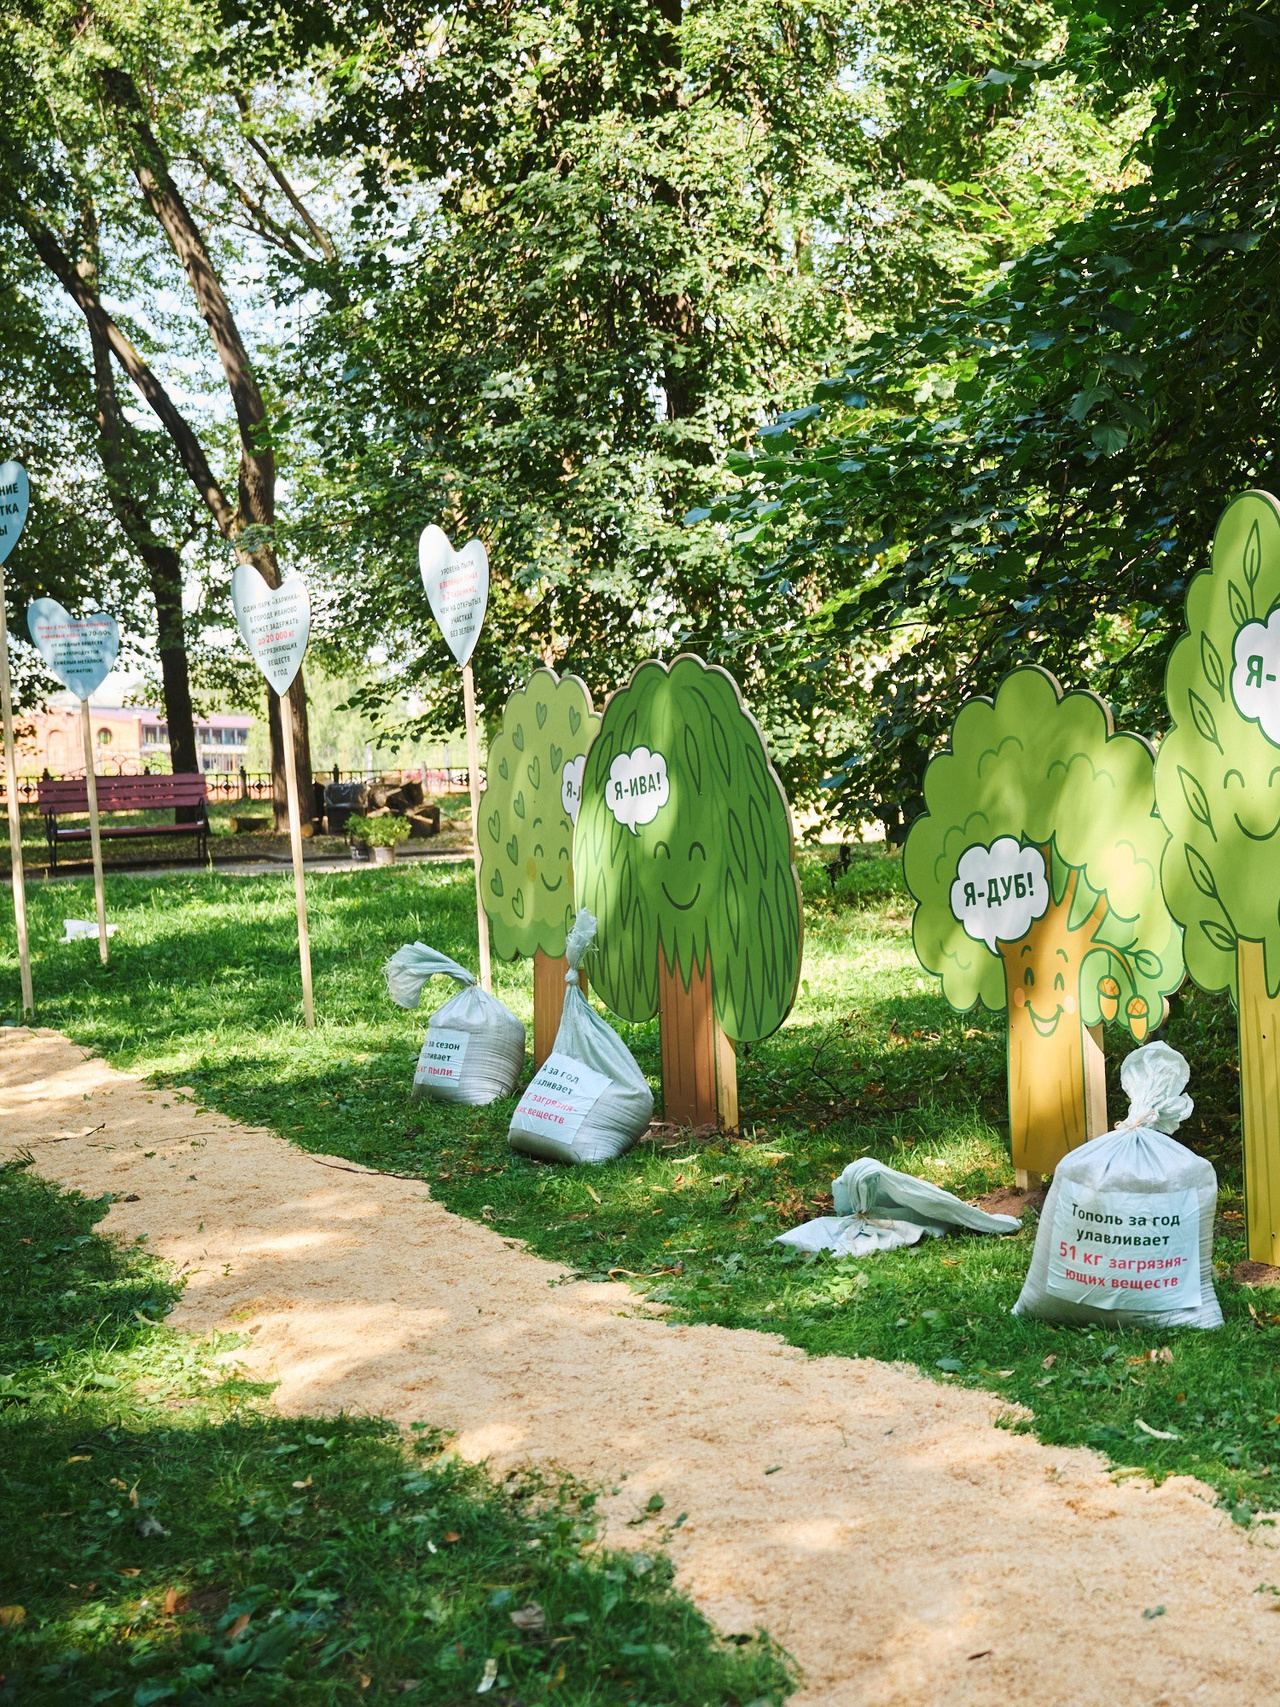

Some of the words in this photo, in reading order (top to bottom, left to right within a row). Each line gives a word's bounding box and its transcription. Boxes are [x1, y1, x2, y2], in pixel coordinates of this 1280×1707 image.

[266, 633, 275, 643] 20
[614, 772, 662, 800] Я-ИВА!
[963, 872, 1034, 908] Я-ДУБ!
[436, 1041, 461, 1051] сезон
[428, 1066, 453, 1077] пыли
[547, 1067, 558, 1076] за
[560, 1070, 580, 1084] год
[532, 1094, 579, 1113] загрязня-
[527, 1107, 565, 1125] веществ
[1072, 1203, 1123, 1226] Тополь
[1128, 1215, 1147, 1227] за
[1152, 1215, 1180, 1227] год
[1076, 1228, 1170, 1247] улавливает
[1059, 1241, 1076, 1261] 51
[1083, 1252, 1103, 1266] кг
[1109, 1256, 1188, 1273] загрязня-
[1065, 1268, 1106, 1287] ющих
[1111, 1277, 1178, 1291] веществ
